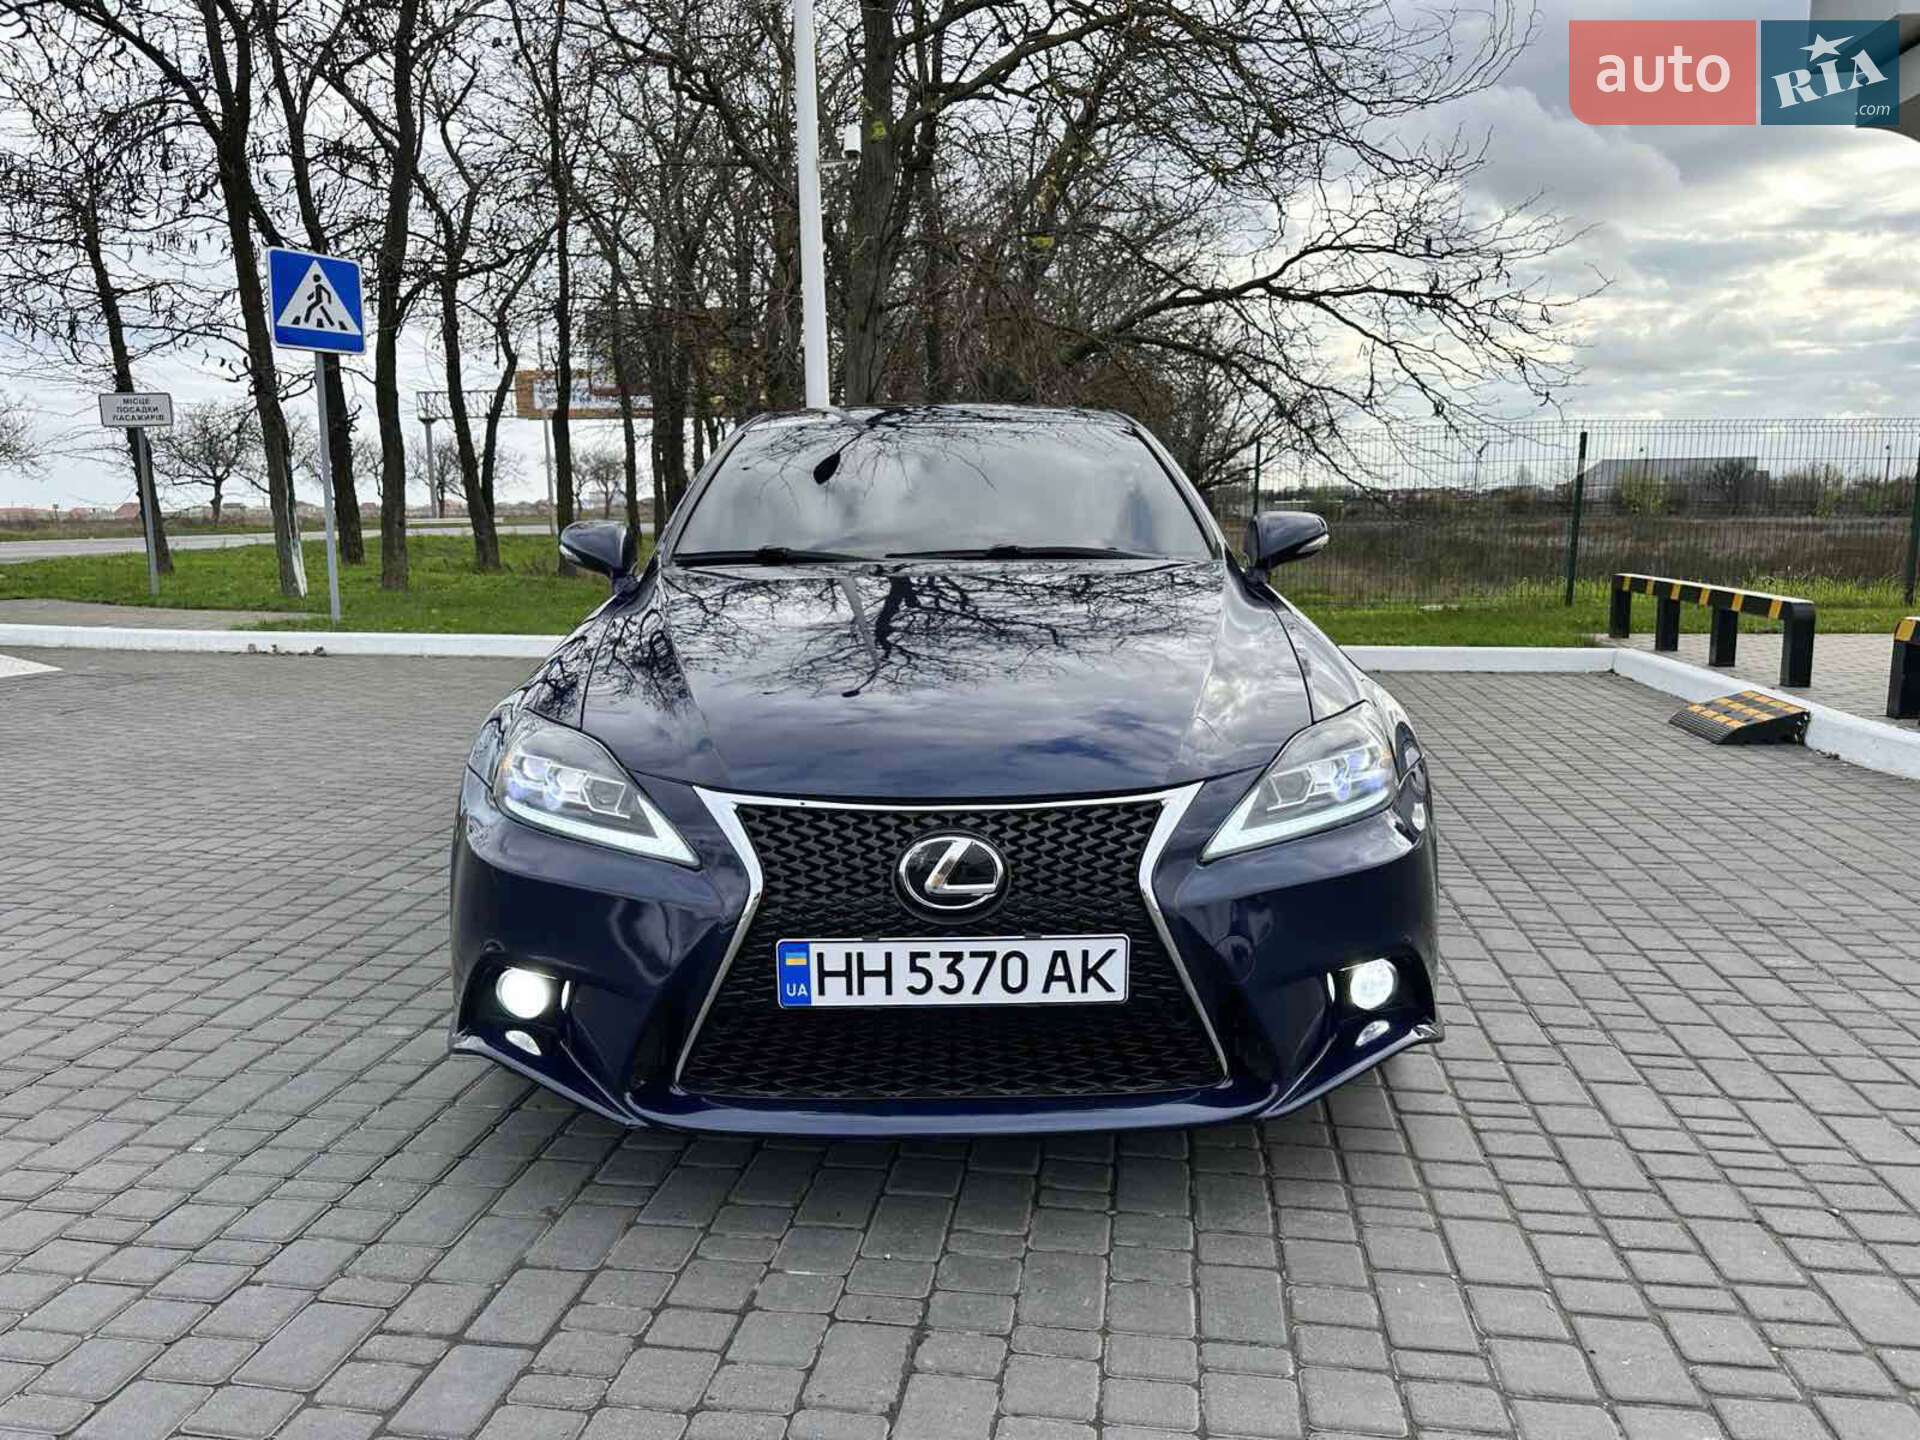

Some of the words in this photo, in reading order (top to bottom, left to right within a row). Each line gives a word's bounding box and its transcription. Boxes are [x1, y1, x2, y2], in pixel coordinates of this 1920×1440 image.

[122, 397, 150, 405] МІСЦЕ
[816, 951, 893, 996] HH
[906, 951, 1029, 995] 5370
[1041, 949, 1117, 994] AK
[785, 983, 808, 998] UA
